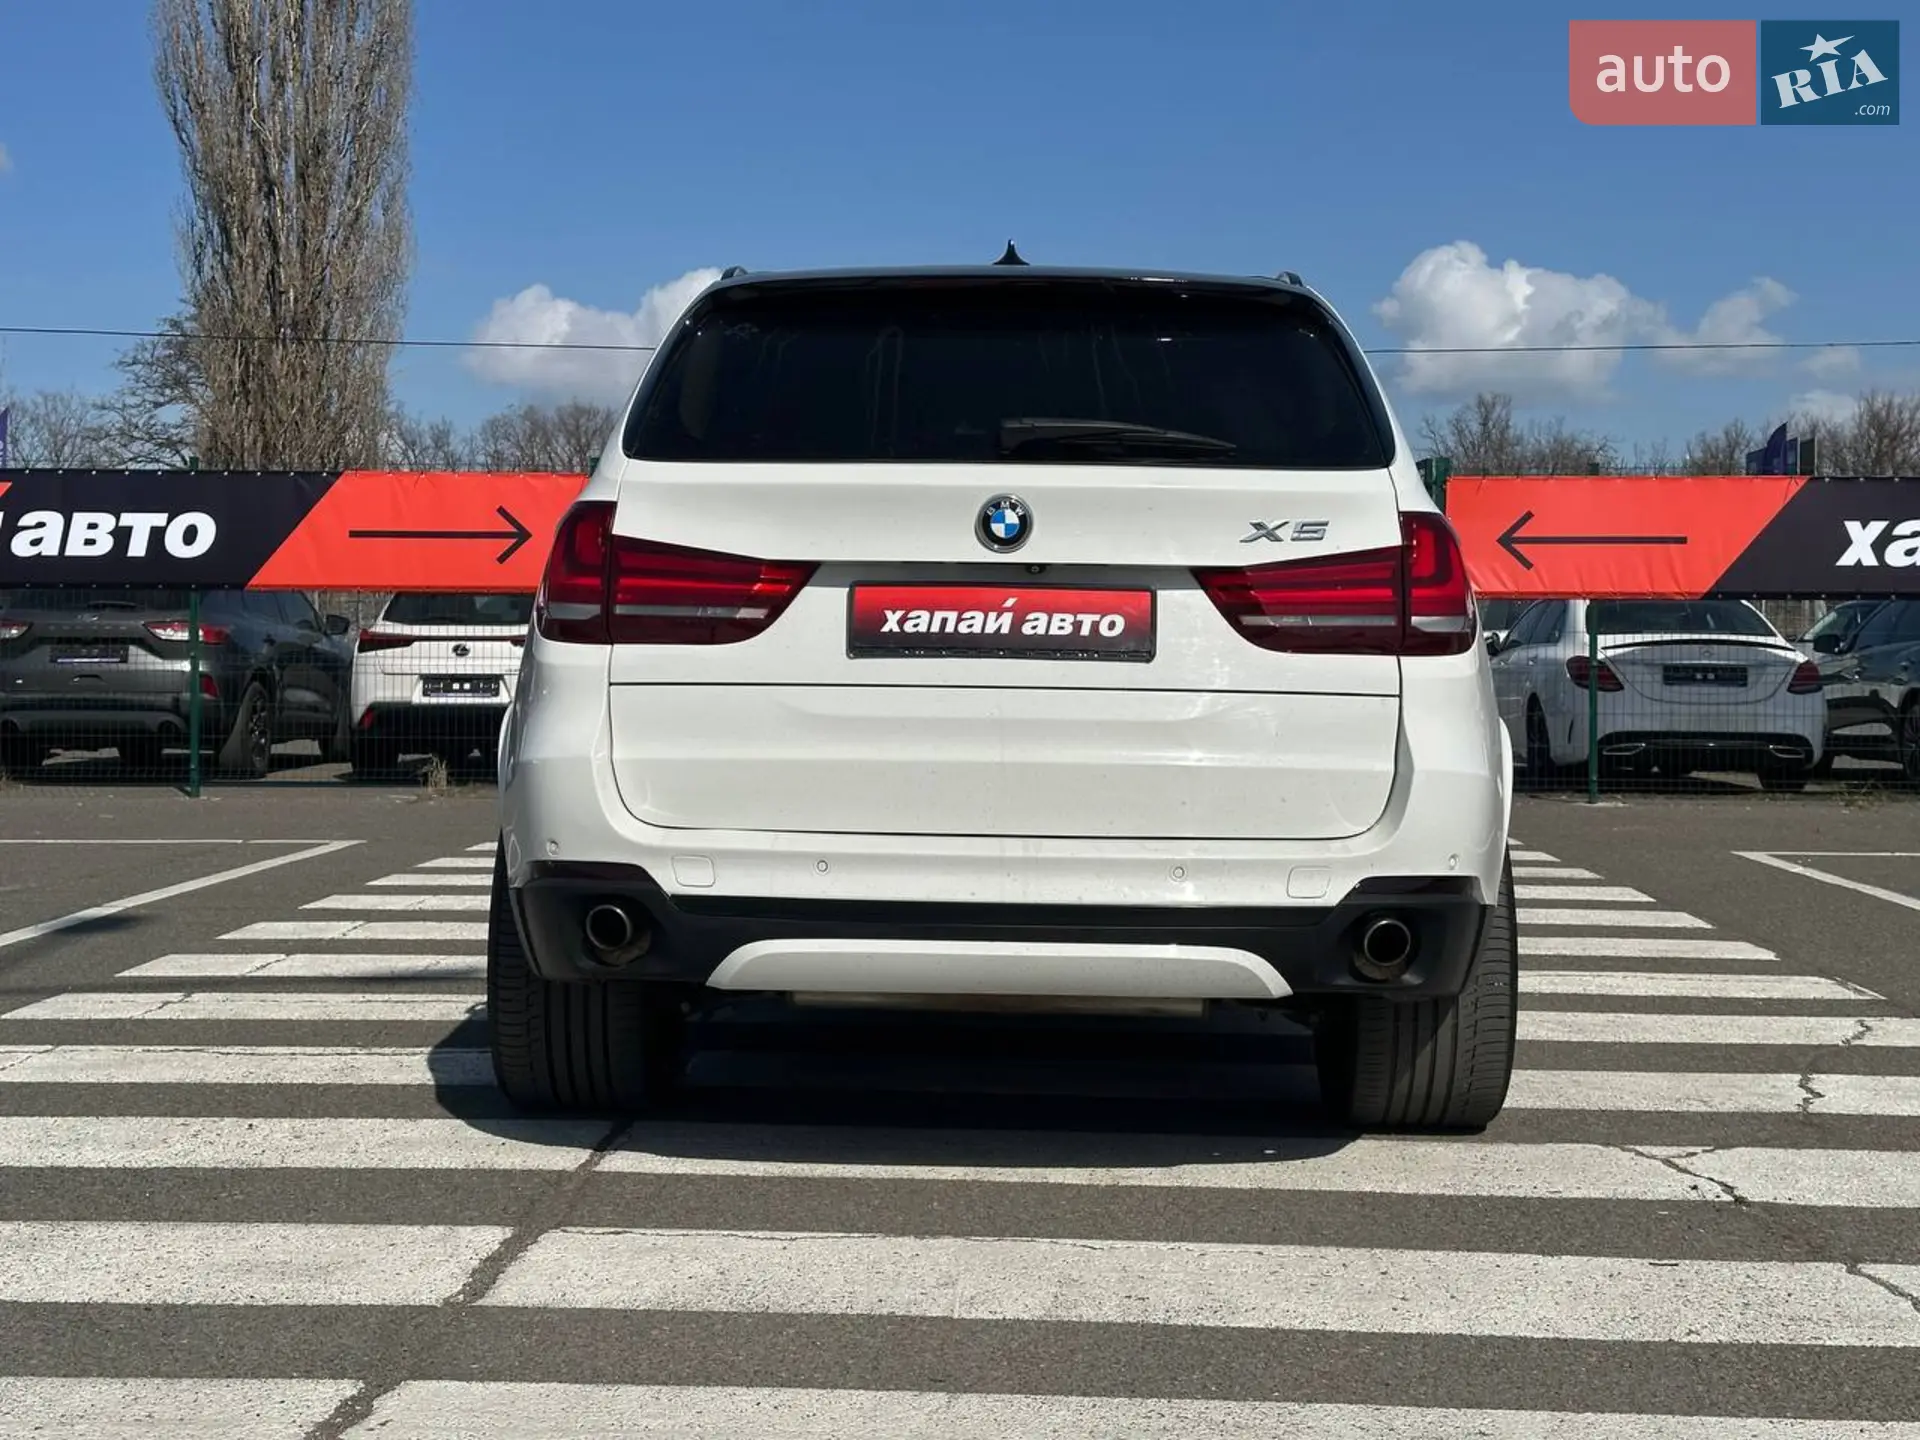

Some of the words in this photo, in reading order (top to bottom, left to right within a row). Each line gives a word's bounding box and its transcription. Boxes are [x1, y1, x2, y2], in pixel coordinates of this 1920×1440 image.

[10, 510, 217, 558] авто
[1239, 520, 1330, 542] X5
[1021, 611, 1126, 637] авто
